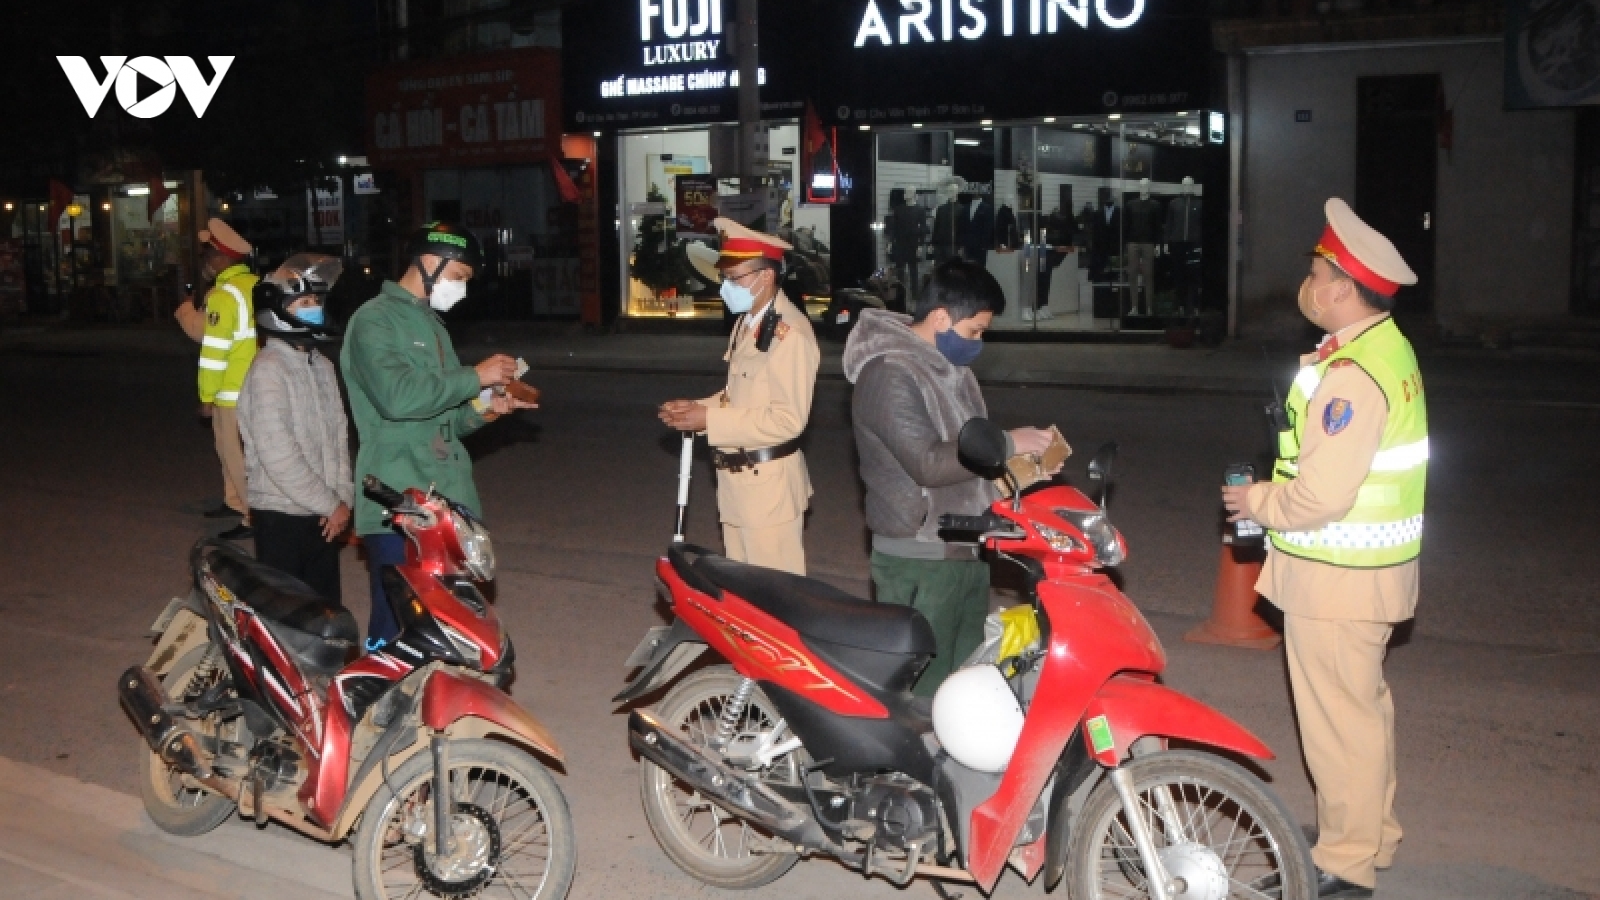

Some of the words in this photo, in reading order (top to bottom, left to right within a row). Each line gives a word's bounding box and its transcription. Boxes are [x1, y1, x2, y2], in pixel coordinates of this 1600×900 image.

[640, 0, 722, 41] FUJI
[854, 0, 1145, 48] ARISTINO
[643, 40, 720, 66] LUXURY
[626, 74, 685, 96] MASSAGE
[459, 94, 489, 142] CÁ
